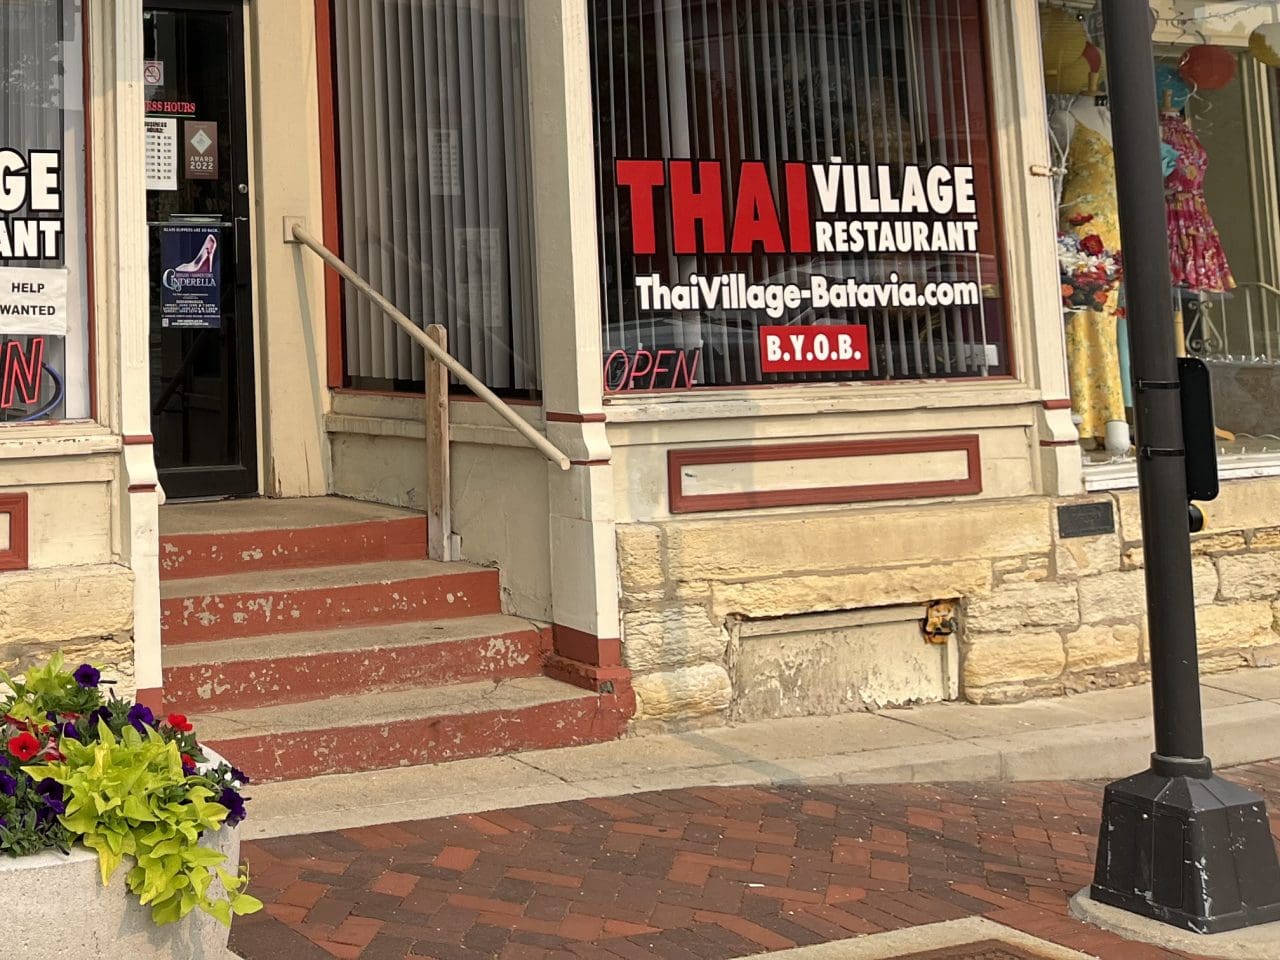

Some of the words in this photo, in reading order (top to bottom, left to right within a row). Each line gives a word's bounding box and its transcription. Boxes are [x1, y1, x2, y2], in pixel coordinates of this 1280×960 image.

[144, 101, 162, 112] ESS
[164, 102, 195, 113] HOURS
[190, 162, 214, 170] 2022
[812, 163, 977, 214] VILLAGE
[615, 158, 812, 255] THAI
[815, 220, 979, 253] RESTAURANT
[11, 282, 45, 293] HELP
[635, 272, 979, 318] ThaiVillage-Batavia.com
[0, 304, 56, 316] WANTED
[766, 334, 862, 362] B.Y.O.B.
[604, 349, 699, 392] OPEN
